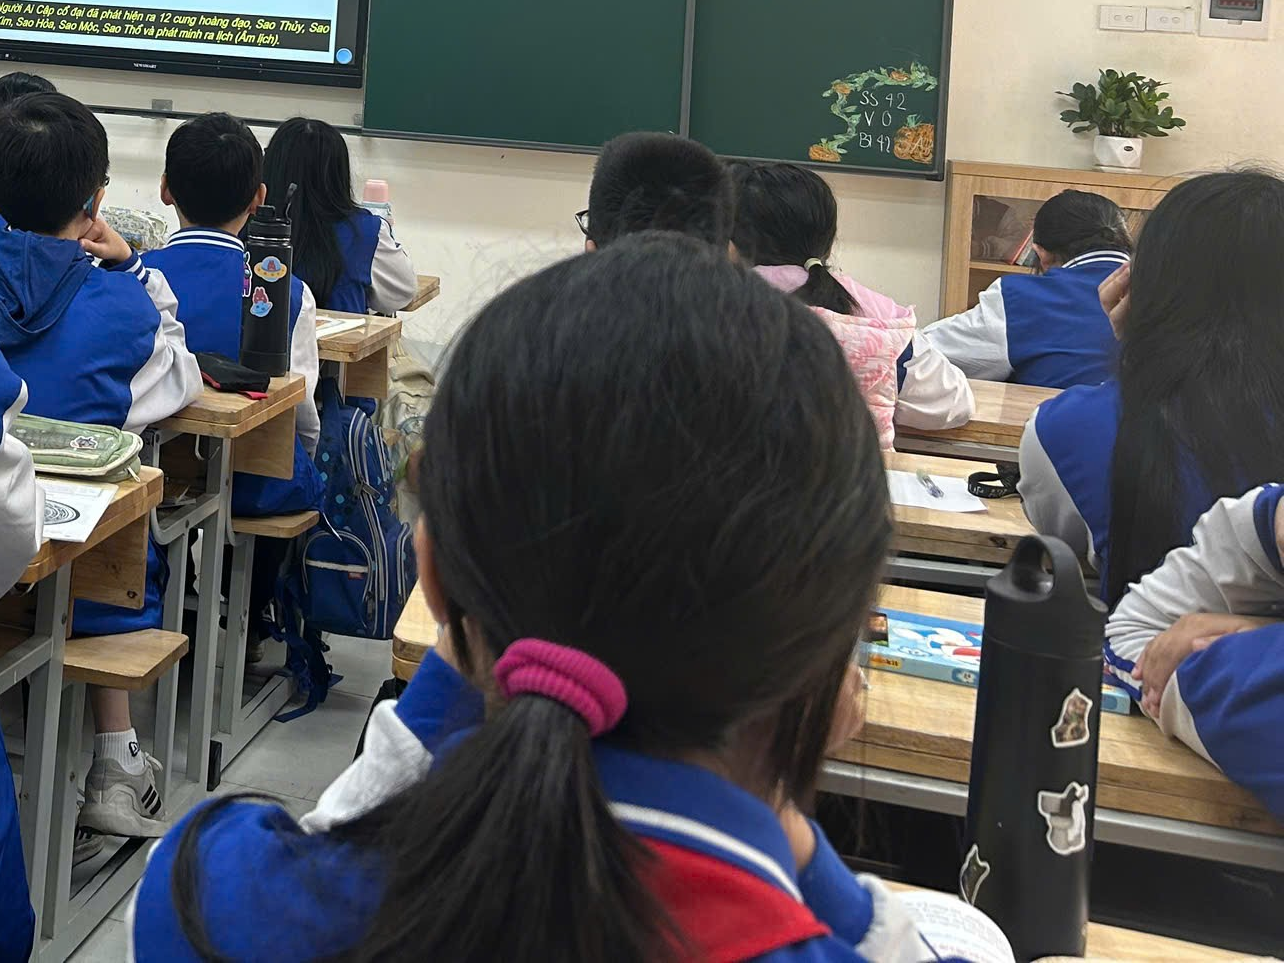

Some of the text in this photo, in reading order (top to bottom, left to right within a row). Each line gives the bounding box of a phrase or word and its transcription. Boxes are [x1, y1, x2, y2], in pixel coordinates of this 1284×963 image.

[23, 4, 34, 14] Ai
[36, 4, 54, 18] Cập
[56, 5, 70, 16] cổ
[70, 6, 85, 19] đại
[86, 7, 98, 18] đã
[100, 6, 123, 21] phát
[123, 8, 144, 23] hiện
[145, 13, 156, 22] ra
[159, 13, 172, 23] 12
[173, 16, 196, 26] cung
[198, 15, 229, 28] hoàng
[231, 17, 252, 31] đạo,
[255, 19, 276, 30] Sao
[279, 20, 305, 34] Thủy,
[308, 22, 330, 34] Sao
[16, 17, 35, 28] Sao
[35, 18, 56, 30] Hỏa,
[58, 20, 77, 31] Sao
[78, 21, 100, 34] Mộc,
[102, 23, 122, 33] Sao
[124, 23, 144, 35] Thổ
[144, 25, 155, 36] và
[155, 27, 179, 39] phát
[179, 29, 202, 40] minh
[204, 32, 215, 41] ra
[216, 30, 234, 44] lịch
[234, 31, 255, 44] (Âm
[257, 34, 280, 47] lịch).
[859, 90, 907, 111] SS 42
[864, 110, 875, 127] V
[876, 134, 891, 153] 42
